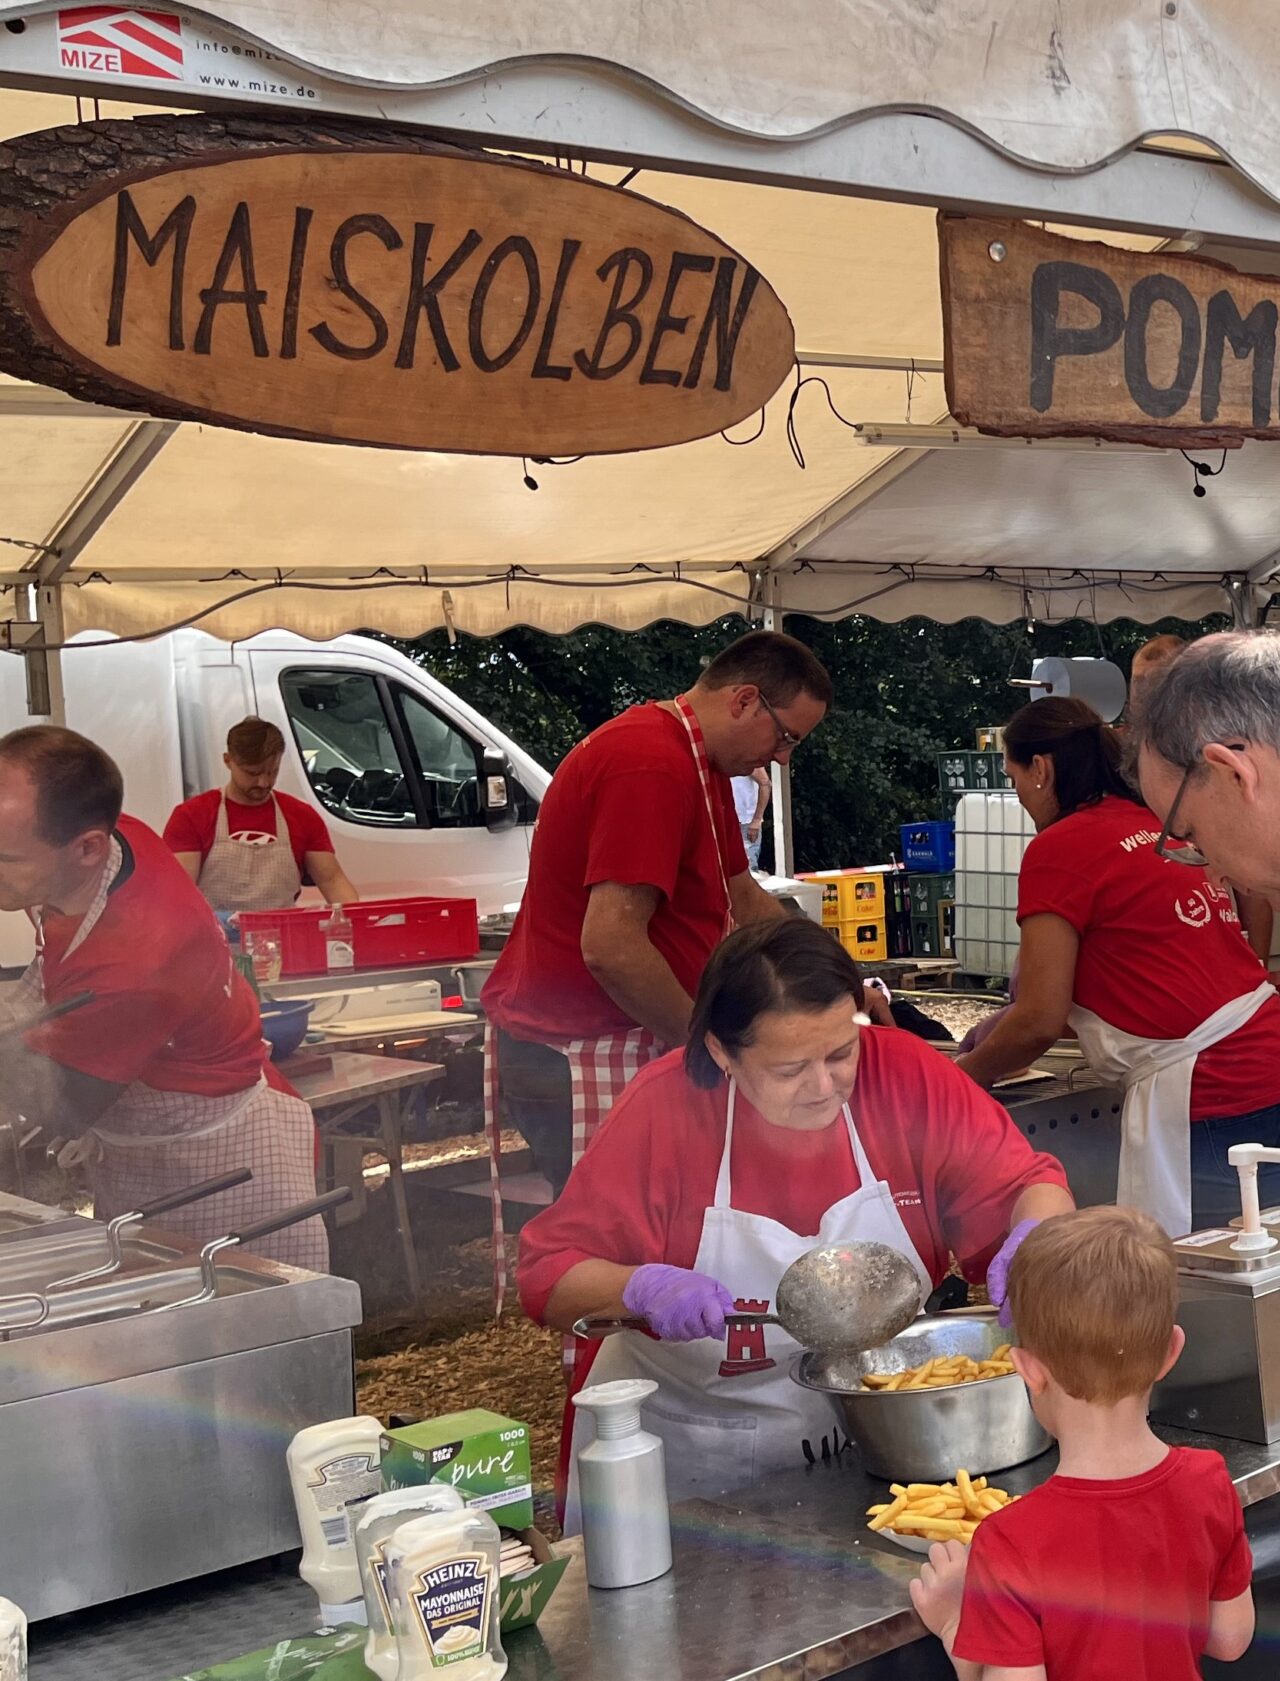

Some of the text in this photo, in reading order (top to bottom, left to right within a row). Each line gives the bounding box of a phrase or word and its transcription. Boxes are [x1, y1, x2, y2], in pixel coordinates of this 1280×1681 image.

[60, 48, 120, 73] MIZE
[199, 74, 316, 98] www.mize.de
[106, 189, 760, 393] MAISKOLBEN
[500, 1428, 526, 1442] 1000
[451, 1449, 515, 1488] pure
[428, 1564, 476, 1588] HEINZ
[420, 1582, 485, 1612] MAYONNAISE
[426, 1607, 442, 1620] DAS
[444, 1598, 481, 1616] ORIGINAL
